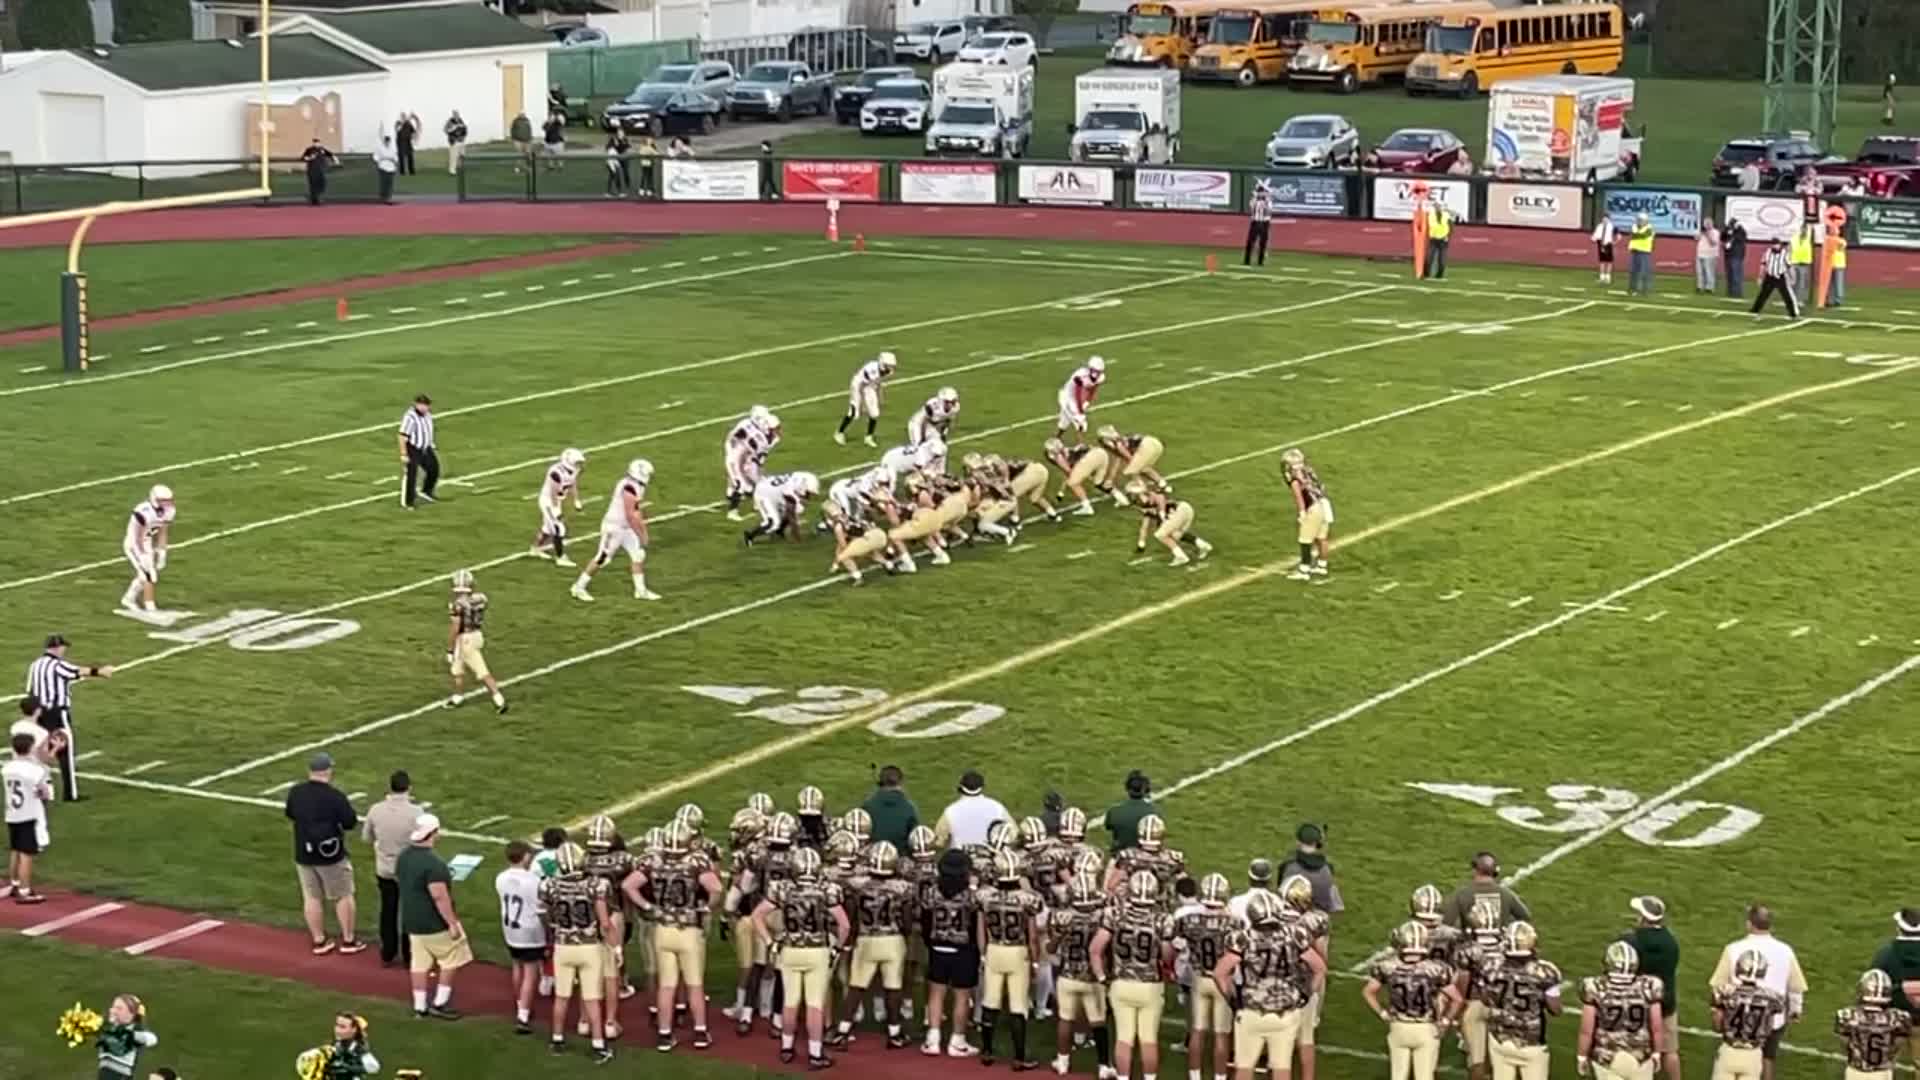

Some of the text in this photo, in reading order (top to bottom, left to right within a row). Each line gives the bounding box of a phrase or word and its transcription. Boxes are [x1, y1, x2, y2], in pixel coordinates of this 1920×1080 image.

[1512, 196, 1554, 208] OLEY
[732, 686, 1006, 737] 20
[1496, 785, 1764, 847] 30
[1117, 929, 1152, 963] 59
[1256, 948, 1289, 979] 74
[1730, 1001, 1765, 1041] 47
